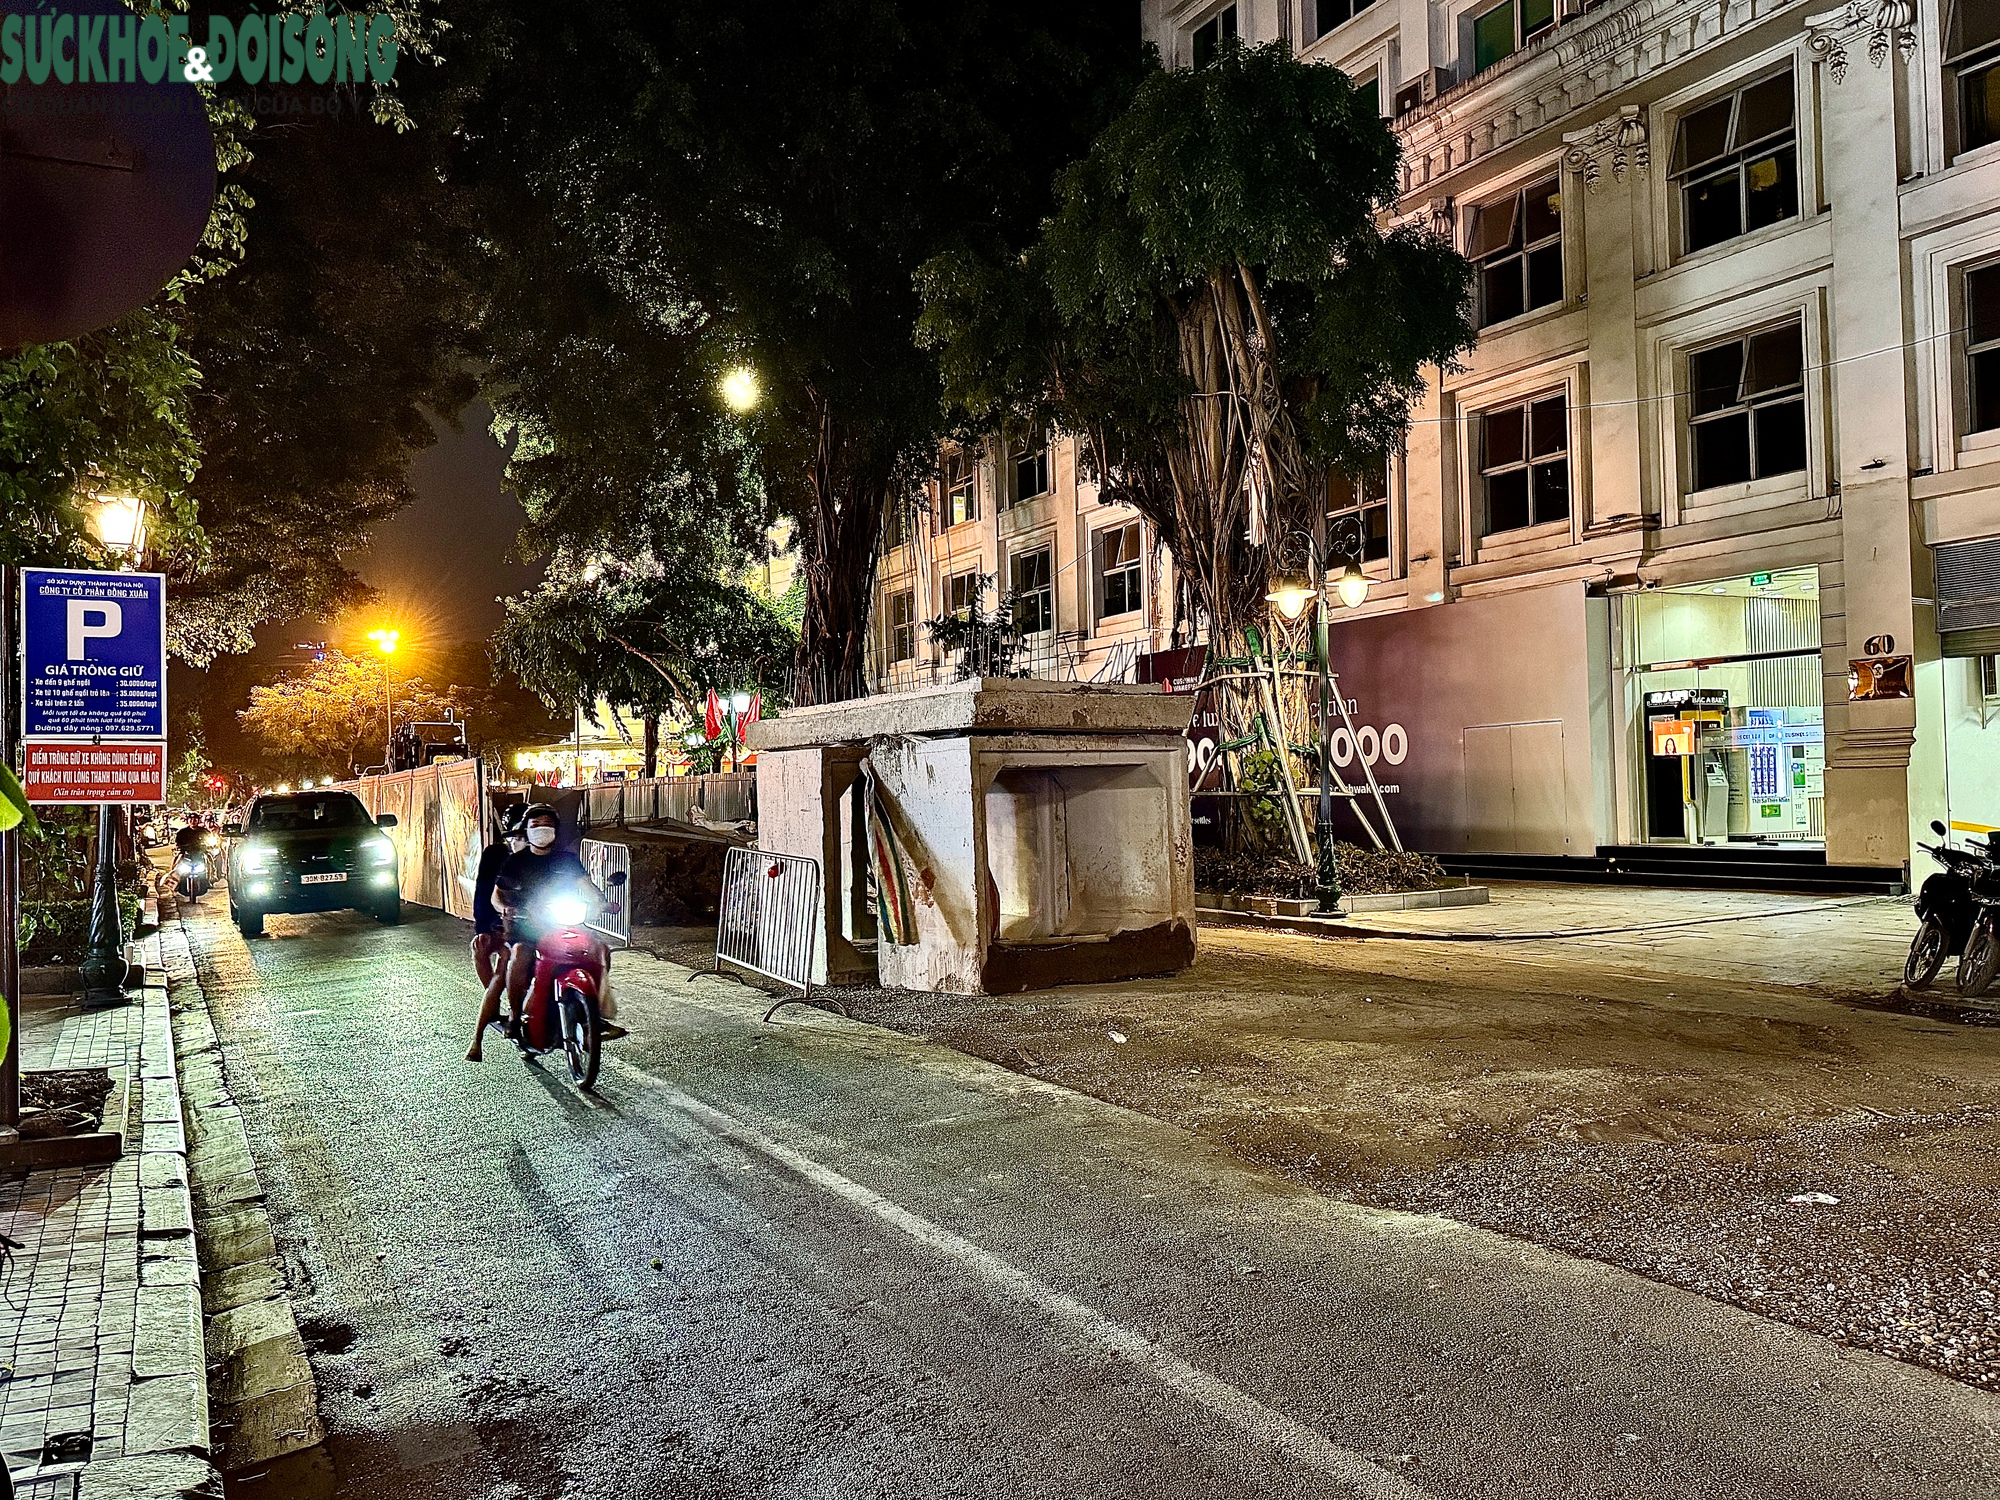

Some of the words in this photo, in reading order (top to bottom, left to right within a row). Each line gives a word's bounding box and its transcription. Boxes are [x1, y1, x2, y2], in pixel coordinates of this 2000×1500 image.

[40, 586, 60, 595] CÔNG
[62, 587, 70, 595] TY
[73, 585, 82, 595] CỔ
[85, 586, 104, 596] PHẦN
[107, 587, 127, 597] ĐỒNG
[129, 589, 148, 598] XUÂN
[67, 599, 122, 660] P
[1864, 634, 1895, 656] 60
[45, 664, 69, 676] GIÁ
[71, 664, 117, 676] TRÔNG
[120, 665, 144, 676] GIỮ
[35, 678, 43, 686] Xe
[45, 678, 56, 686] đến
[63, 678, 76, 686] ghế
[80, 725, 103, 733] nóng:
[32, 747, 48, 765] ĐIỂM
[49, 750, 69, 765] TRÔNG
[70, 750, 81, 765] GIỮ
[81, 752, 89, 765] XE
[91, 750, 111, 765] KHÔNG
[112, 750, 128, 765] DÙNG
[143, 750, 156, 768] MẶT
[28, 768, 40, 785] QUÝ
[41, 768, 61, 783] KHÁCH
[63, 771, 72, 783] VUI
[74, 768, 89, 783] LÒNG
[91, 771, 110, 783] THANH
[111, 768, 127, 783] TOÁN
[128, 771, 139, 784] QUA
[141, 768, 150, 783] MÃ
[151, 771, 160, 784] QR
[54, 788, 69, 797] (Xin
[71, 788, 85, 796] trân
[87, 789, 105, 797] trọng
